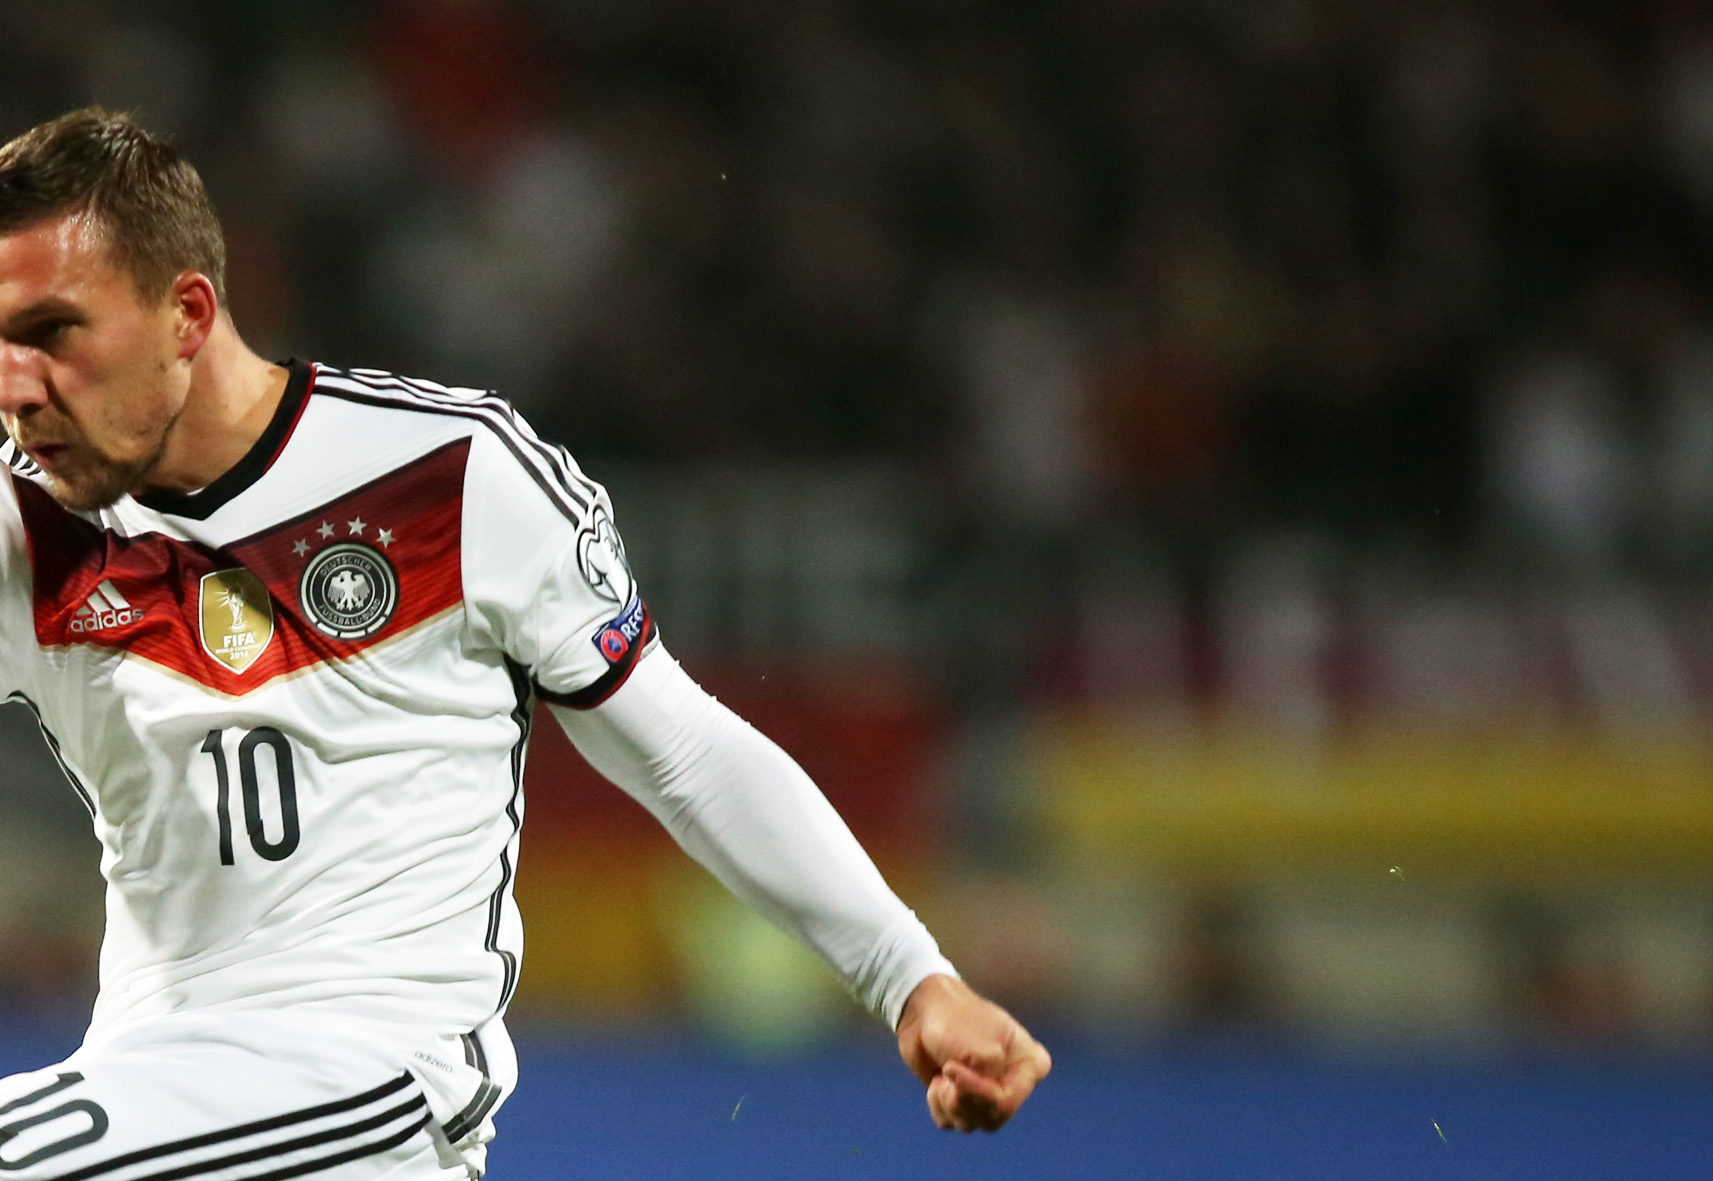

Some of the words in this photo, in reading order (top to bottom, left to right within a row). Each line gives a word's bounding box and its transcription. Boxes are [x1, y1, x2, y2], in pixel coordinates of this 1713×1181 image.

[319, 555, 372, 577] DEUTSCHER
[70, 608, 145, 633] adidas
[223, 632, 256, 648] FIFA
[200, 725, 301, 866] 10
[414, 1051, 453, 1073] adizero
